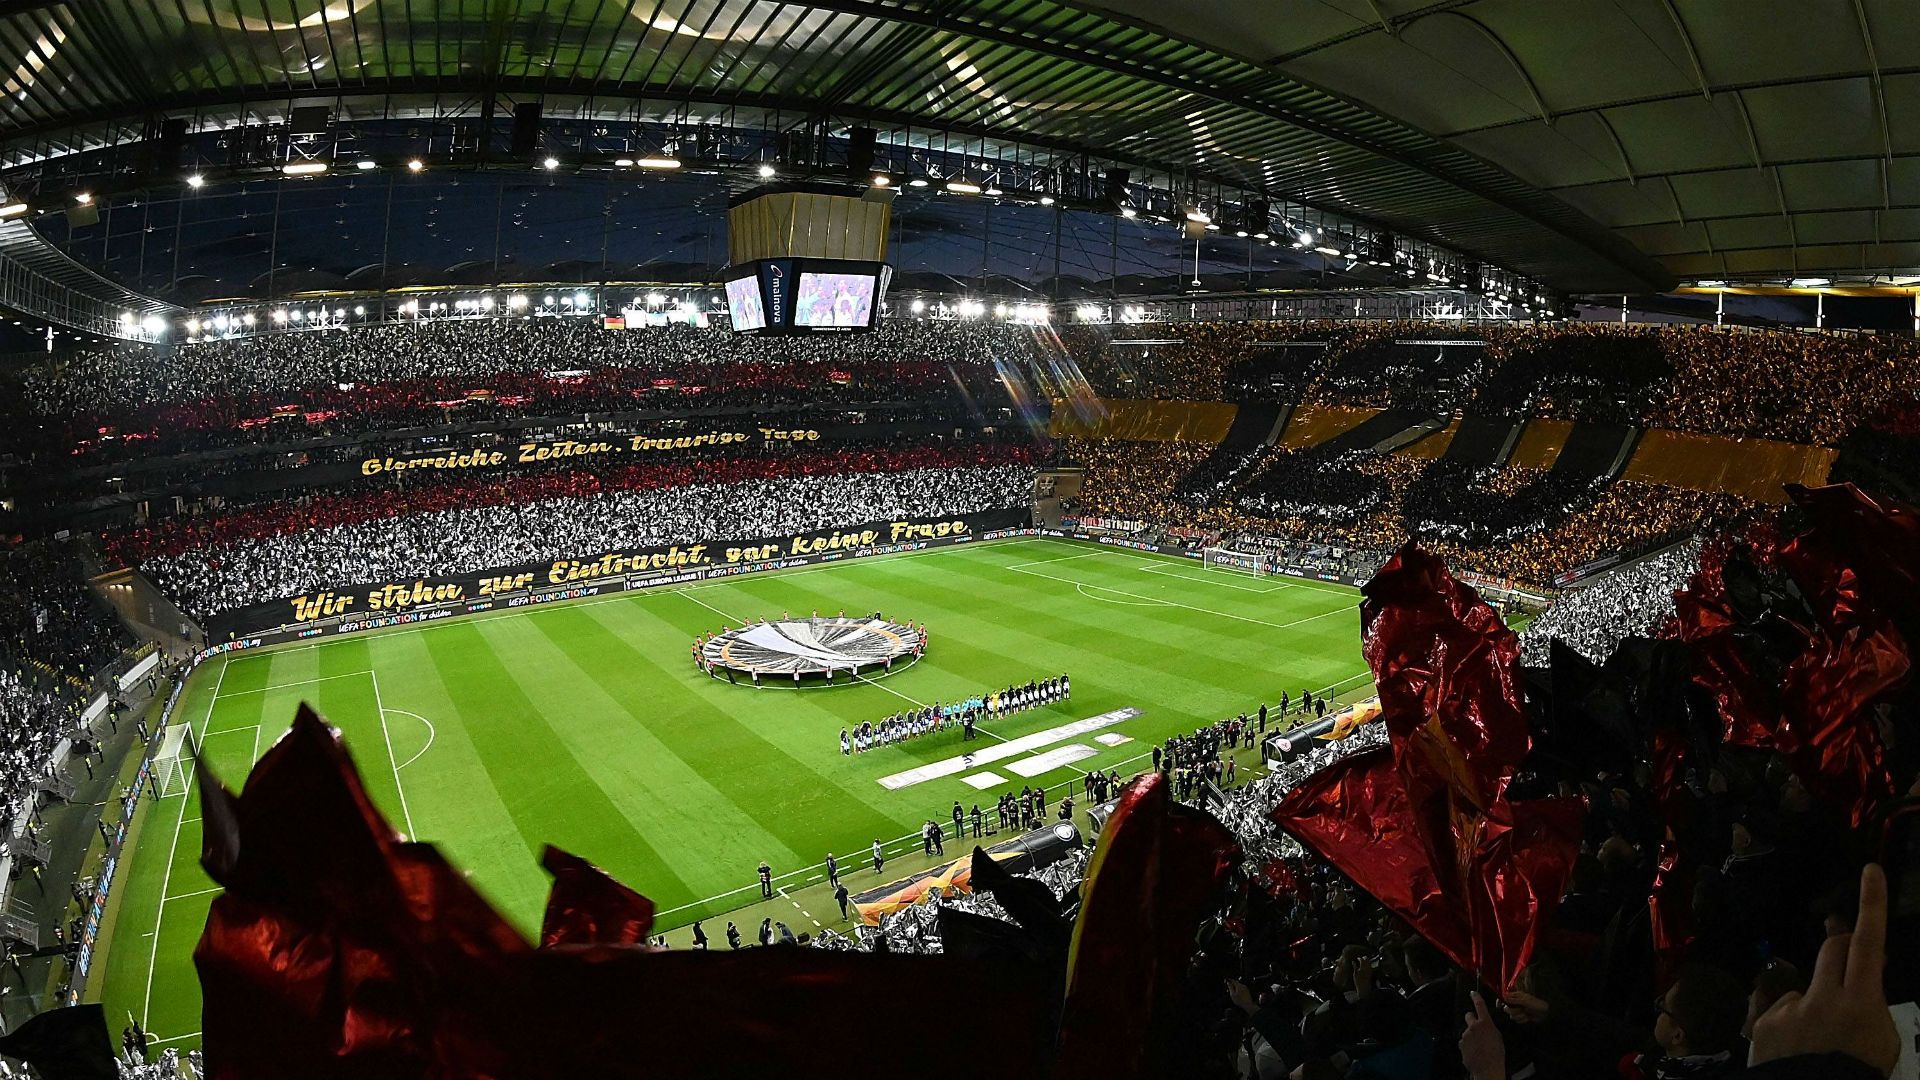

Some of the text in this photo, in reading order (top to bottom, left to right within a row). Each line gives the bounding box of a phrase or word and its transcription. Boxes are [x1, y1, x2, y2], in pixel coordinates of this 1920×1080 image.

[772, 278, 781, 323] mainova
[361, 448, 507, 475] Glorreiche
[629, 431, 751, 451] traurige
[758, 427, 821, 441] Tage
[998, 527, 1040, 539] FOUNDATION
[855, 549, 872, 557] UEFA
[291, 592, 354, 622] Wir
[368, 580, 463, 610] stehn
[479, 571, 535, 596] zur
[725, 543, 779, 564] gar
[790, 530, 879, 555] keine
[708, 569, 727, 578] UEFA
[727, 561, 780, 576] FOUNDATION
[649, 576, 673, 586] EUROPA
[673, 573, 696, 582] LEAGUE
[508, 596, 529, 606] UEFA
[338, 609, 452, 633] UEFA FOUNDATION for children
